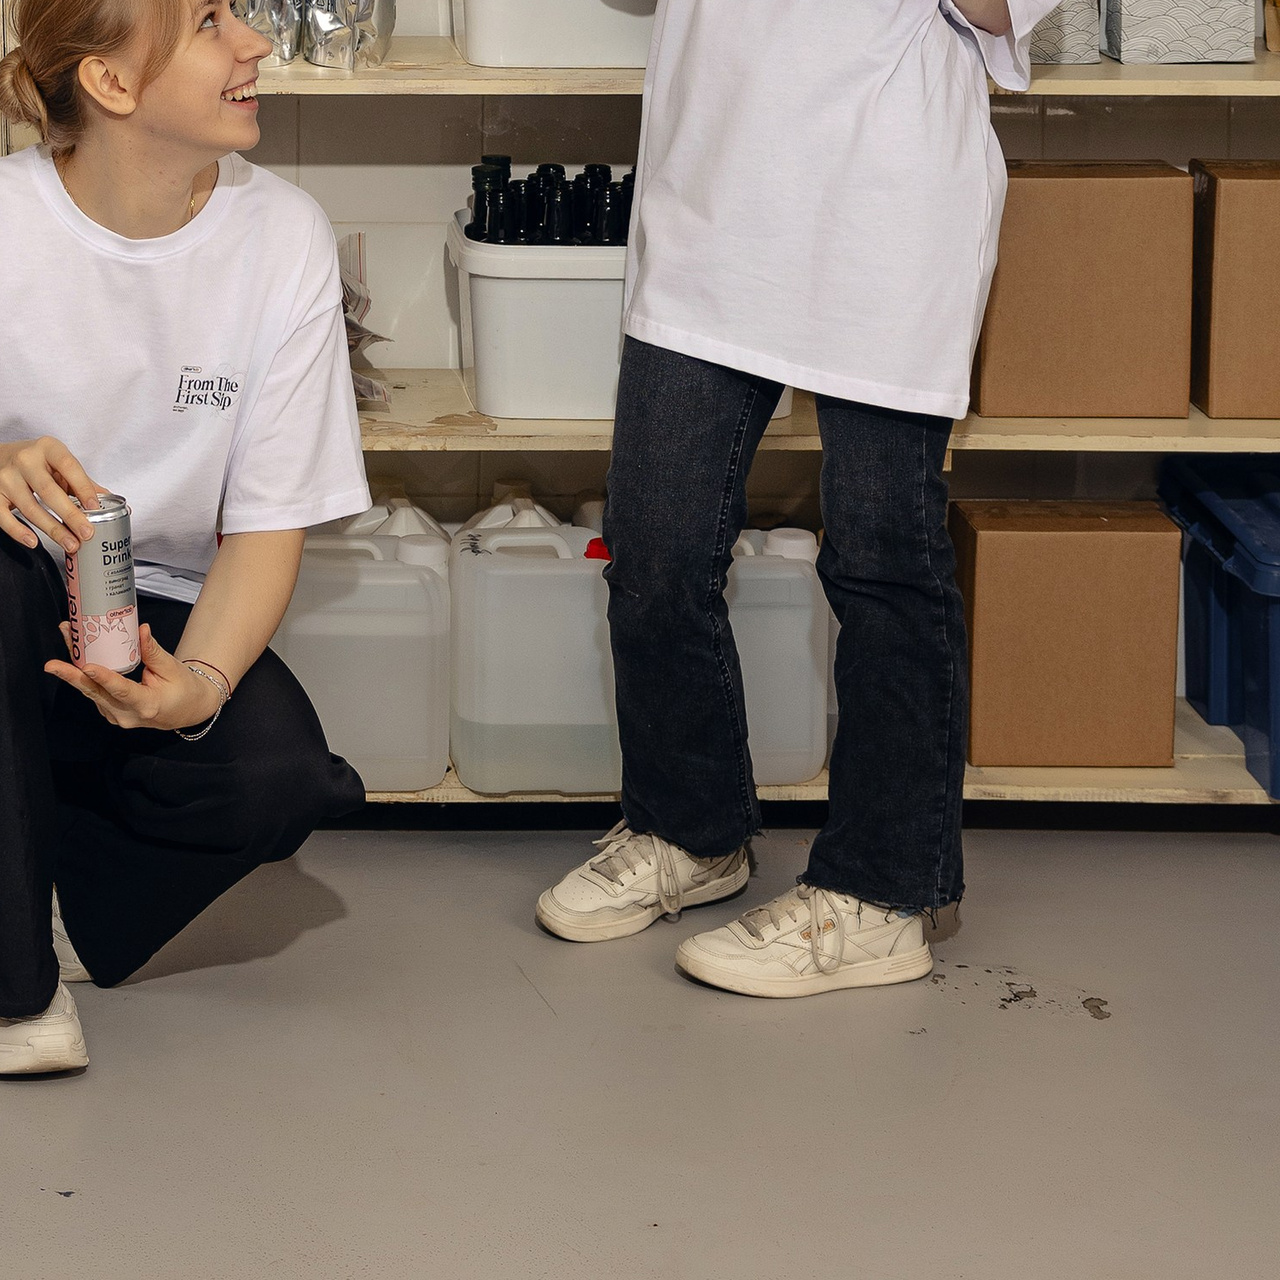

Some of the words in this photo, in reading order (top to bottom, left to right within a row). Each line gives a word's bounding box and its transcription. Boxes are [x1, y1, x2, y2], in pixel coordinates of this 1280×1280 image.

[179, 375, 213, 390] From
[216, 377, 238, 392] The
[175, 390, 208, 405] First
[211, 392, 231, 410] Sip
